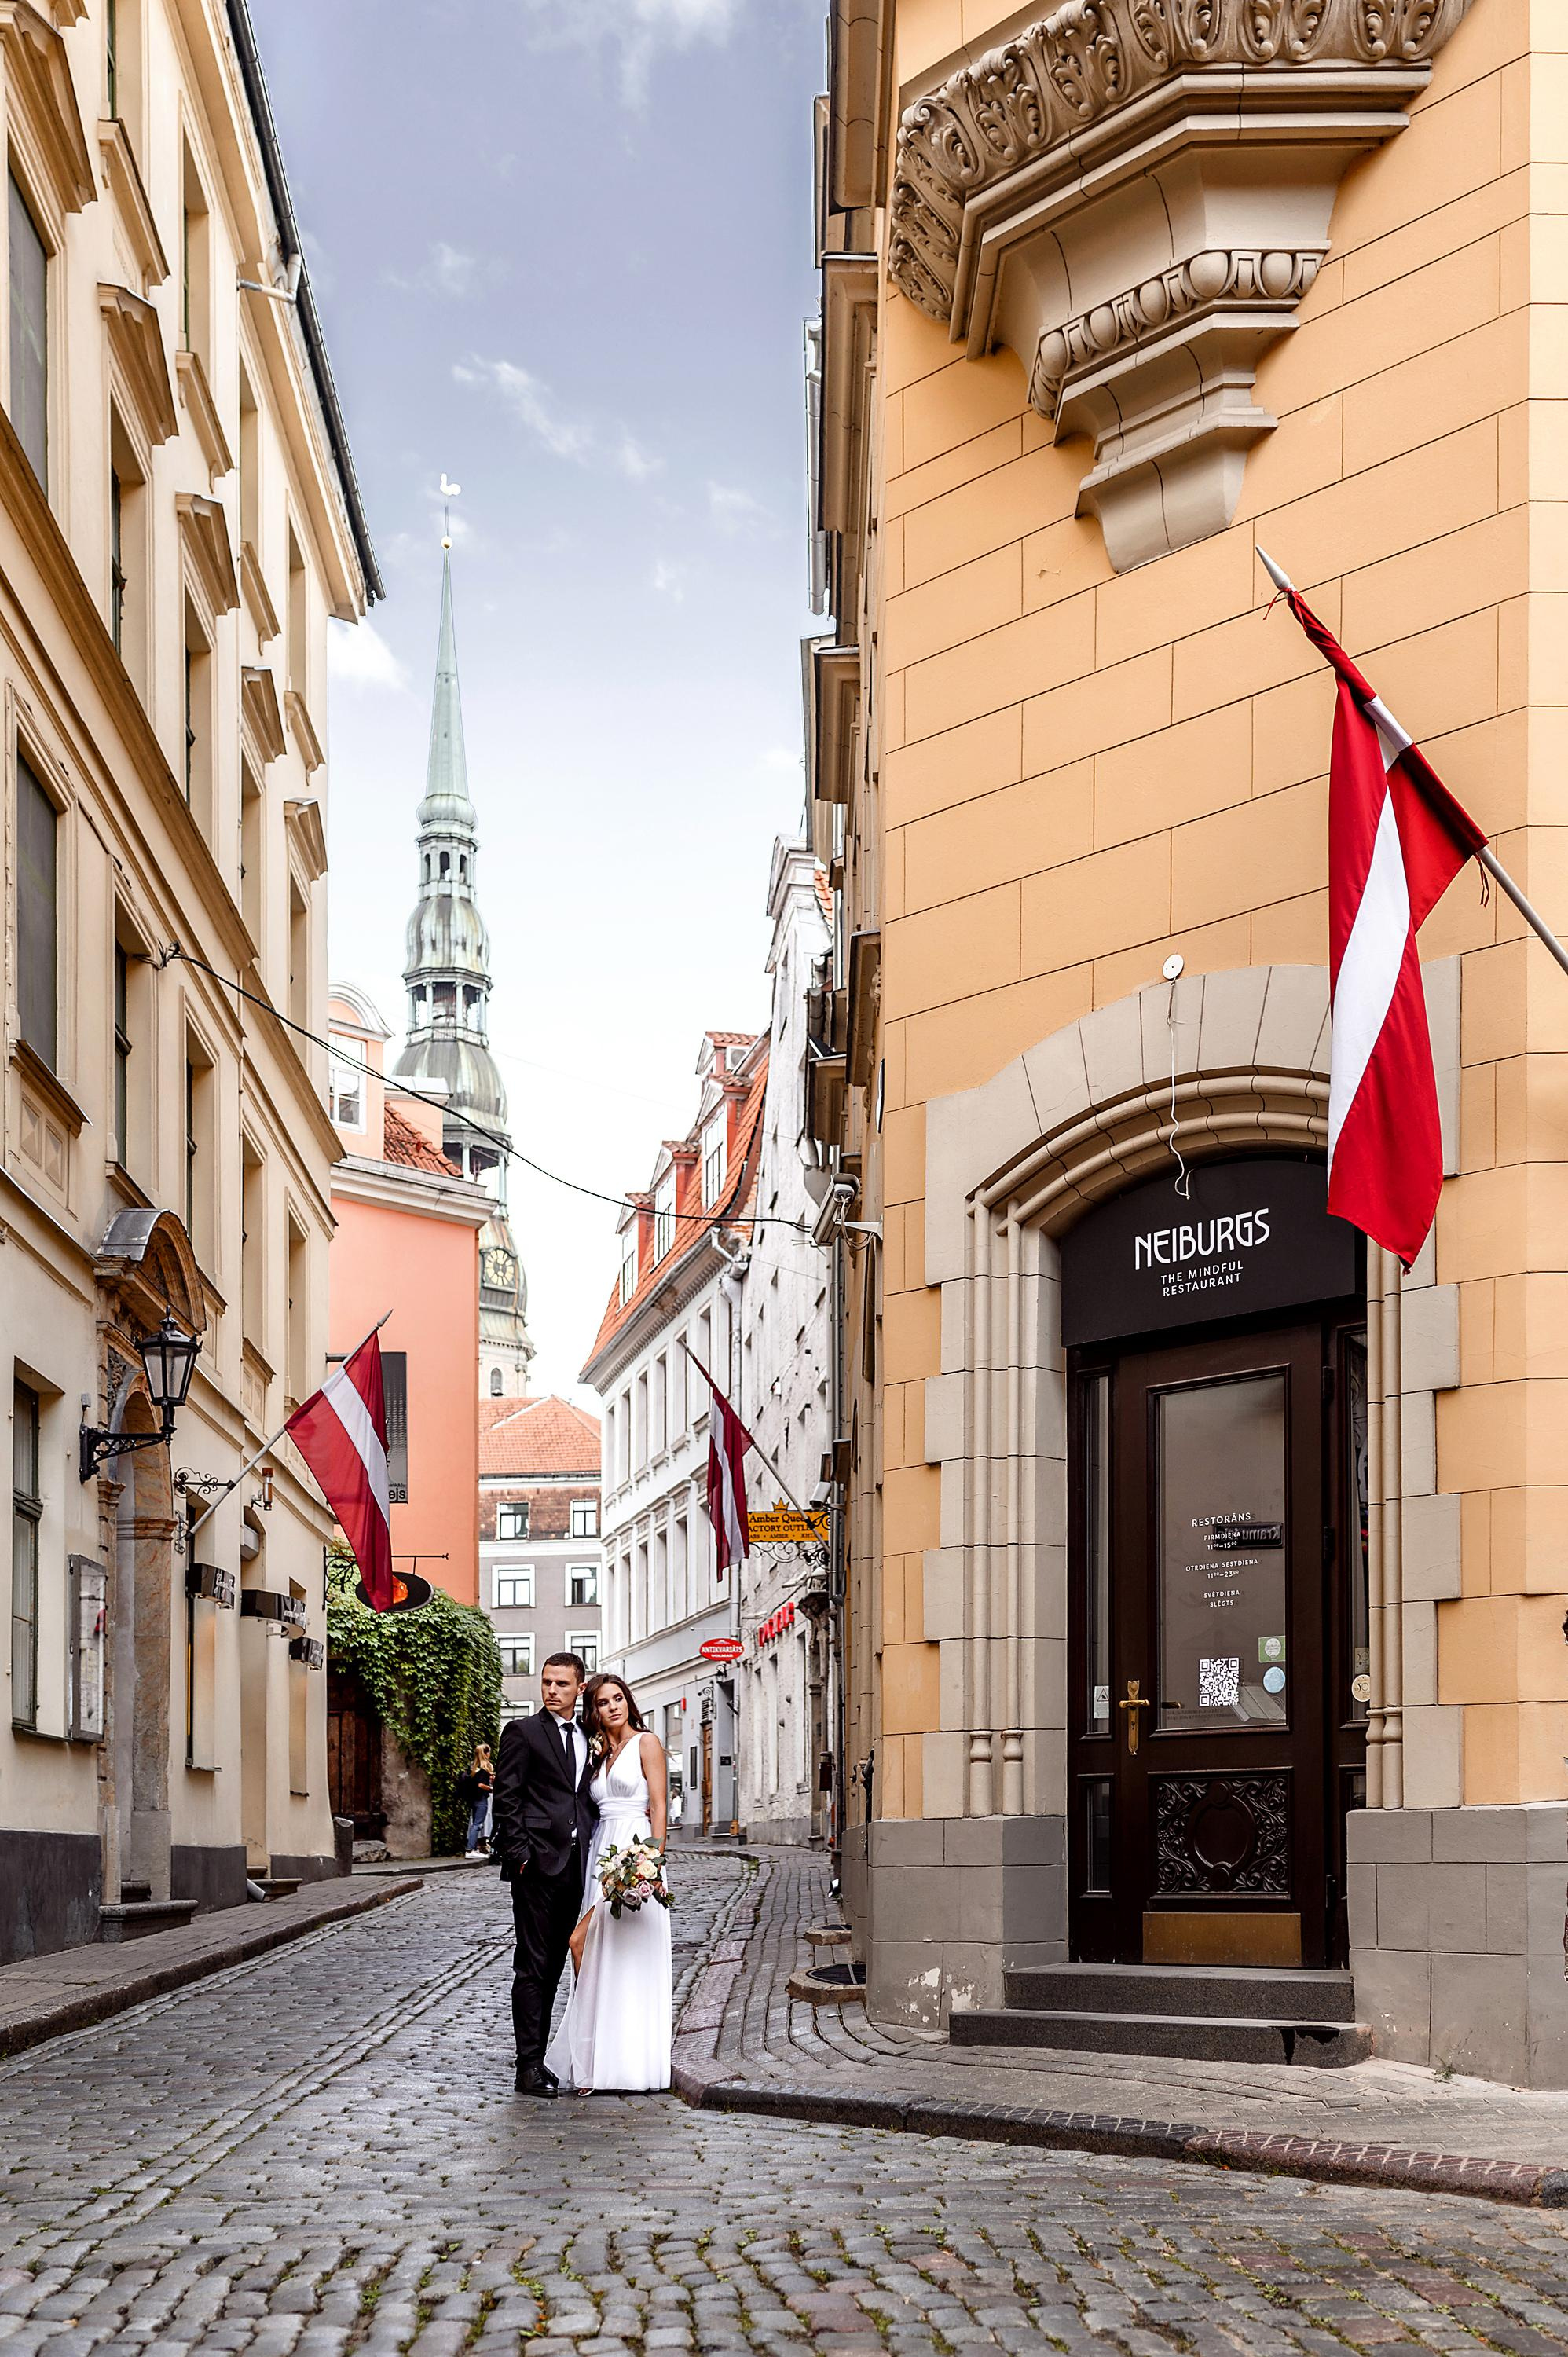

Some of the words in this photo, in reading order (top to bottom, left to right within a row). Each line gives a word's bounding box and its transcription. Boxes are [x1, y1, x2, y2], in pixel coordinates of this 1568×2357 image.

[1134, 1208, 1270, 1270] NEIBURGS
[1160, 1271, 1183, 1285] THE
[1188, 1260, 1244, 1280] MINDFUL
[1163, 1272, 1242, 1296] RESTAURANT
[749, 1513, 779, 1523] Amber
[782, 1513, 811, 1523] Quee
[1192, 1512, 1251, 1527] RESTORĀNS
[1203, 1531, 1241, 1541] PIRMDIENA
[1185, 1563, 1219, 1572] OTRDIENA
[1222, 1558, 1258, 1568] SESTDIENA
[1203, 1589, 1240, 1599] SVĒTDIENA
